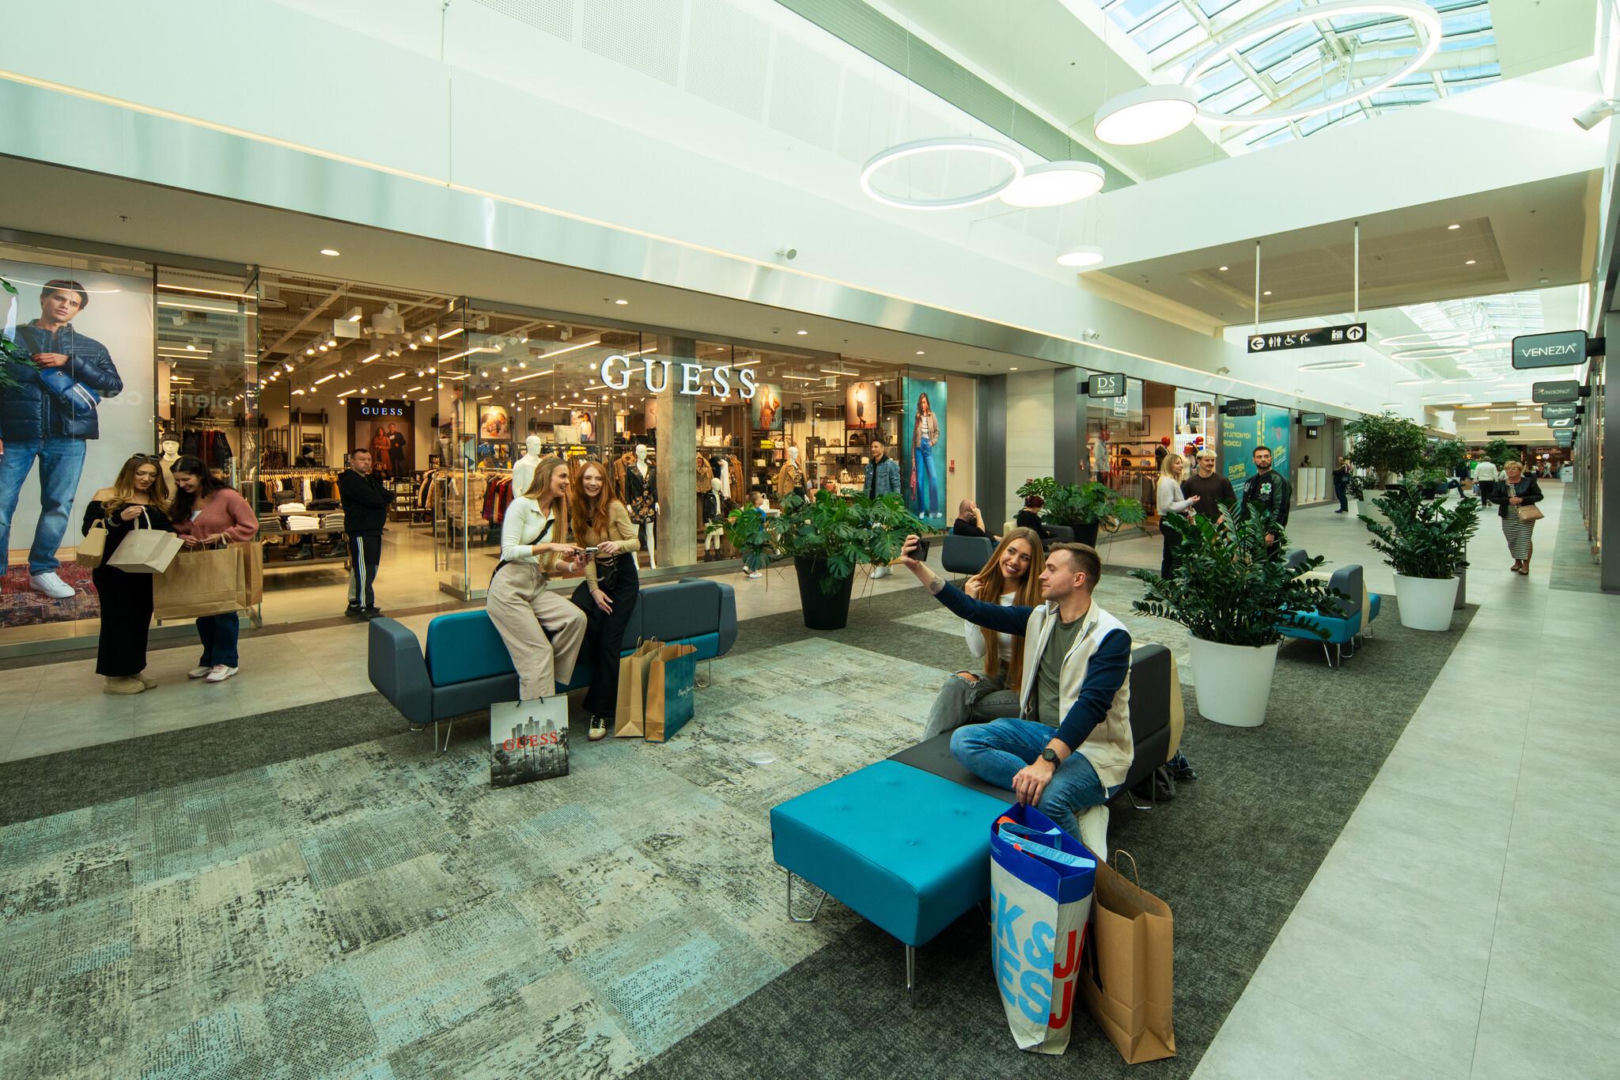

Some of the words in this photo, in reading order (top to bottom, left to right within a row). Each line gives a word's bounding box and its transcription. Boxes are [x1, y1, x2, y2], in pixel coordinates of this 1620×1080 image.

[1522, 343, 1576, 357] VENEZIA
[601, 355, 756, 399] GUESS
[361, 407, 403, 416] GUESS
[503, 730, 558, 752] GUESS
